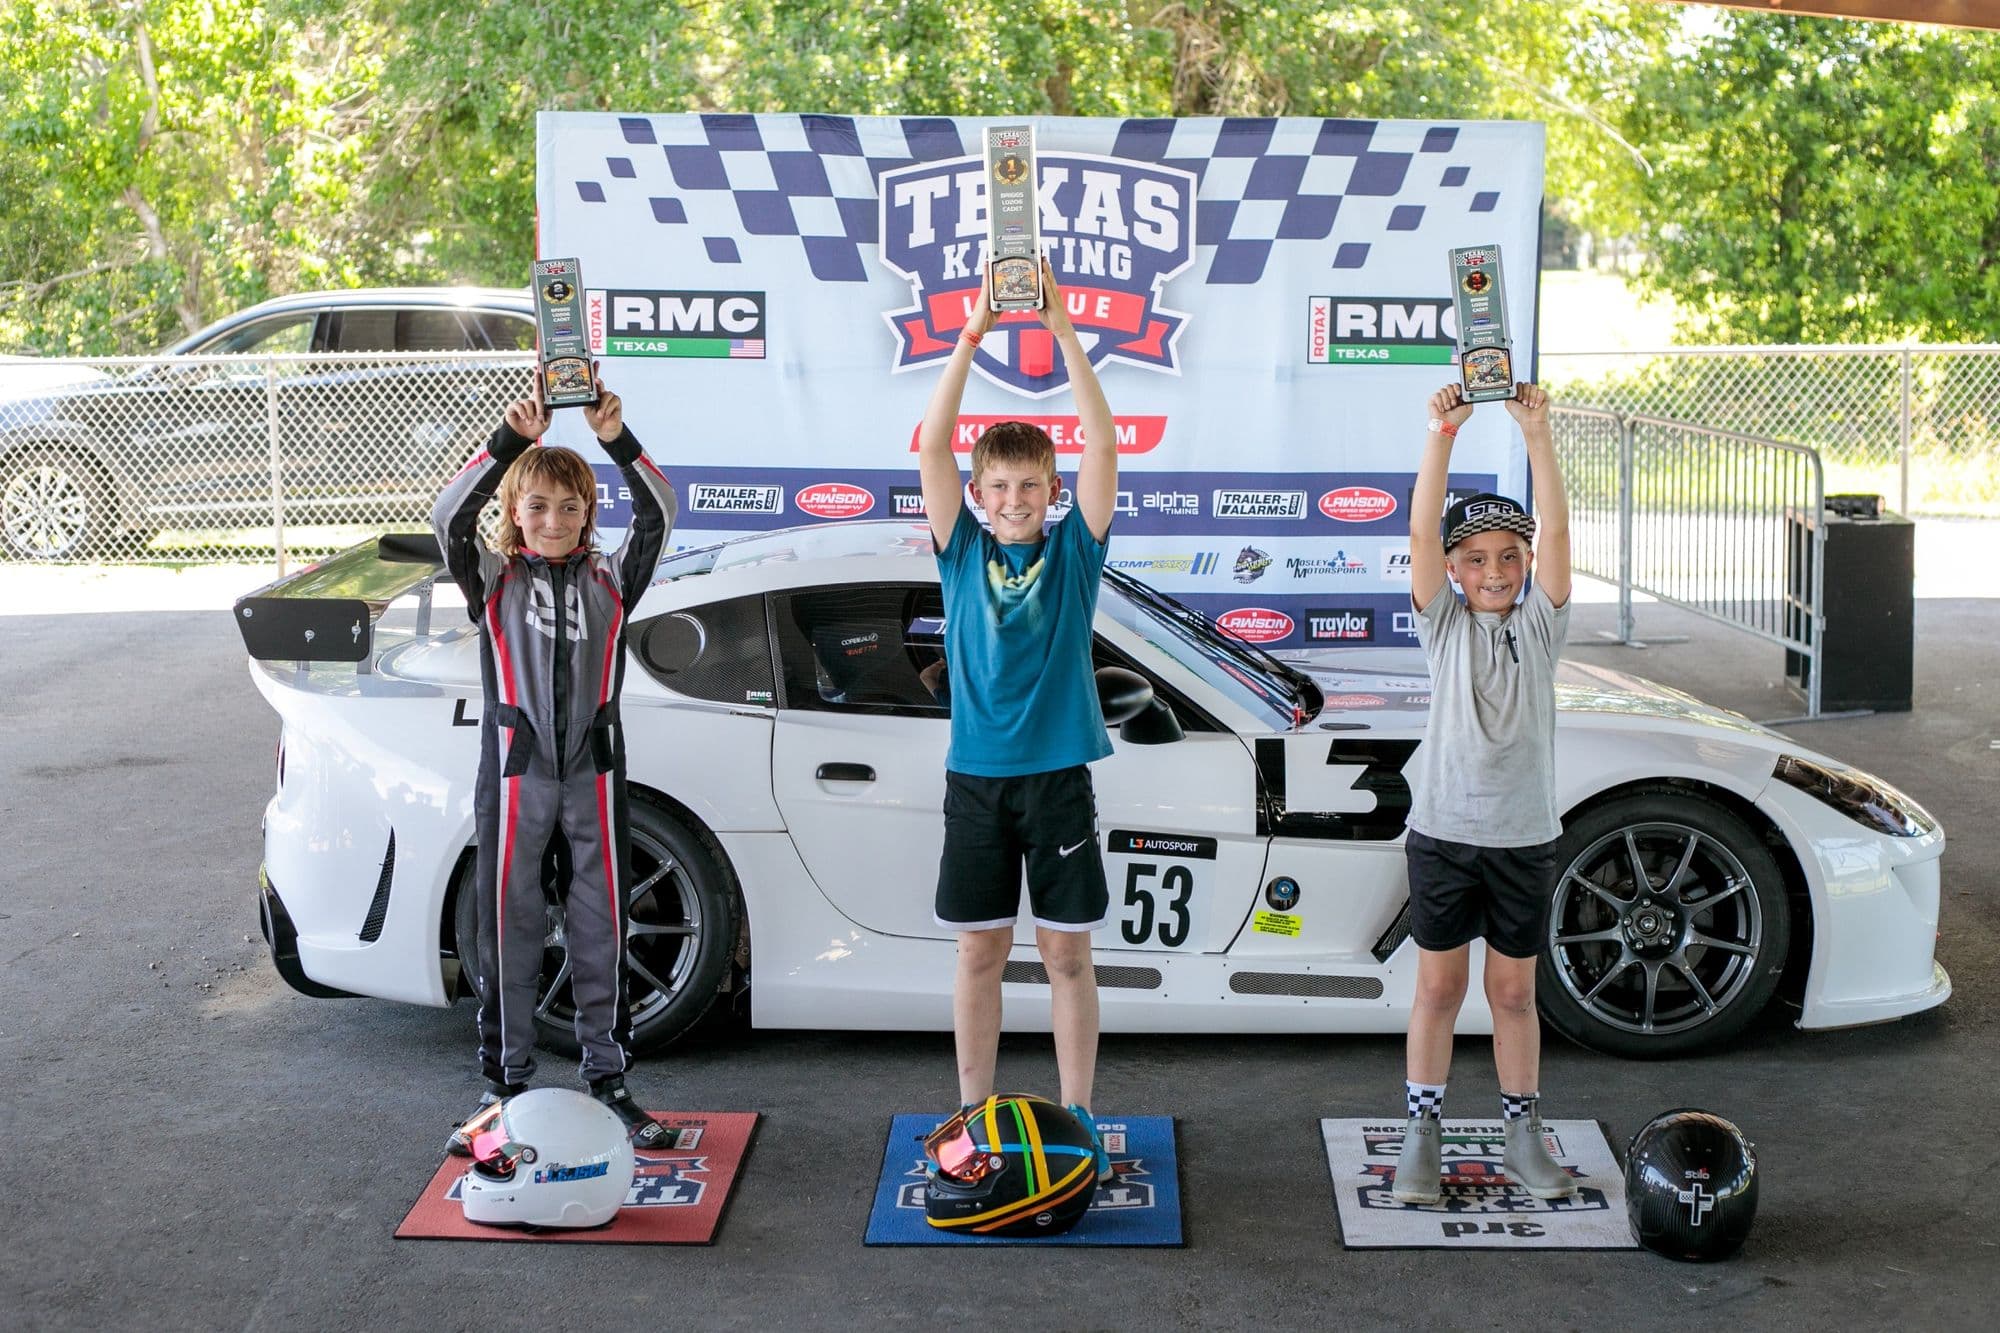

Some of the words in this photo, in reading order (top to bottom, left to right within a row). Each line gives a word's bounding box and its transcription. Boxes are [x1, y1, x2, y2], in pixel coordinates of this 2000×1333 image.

[942, 237, 1132, 280] KTING
[613, 296, 760, 333] RMC
[591, 298, 602, 349] ROTAX
[1314, 306, 1325, 357] ROTAX
[613, 340, 668, 351] TEXAS
[1336, 349, 1390, 359] TEXAS
[801, 492, 868, 504] LAWSON
[1143, 491, 1199, 513] alpha
[1323, 496, 1390, 508] LAWSON
[706, 499, 763, 510] ALARMS
[1229, 505, 1288, 515] ALARMS
[1469, 503, 1513, 517] SPR
[1108, 559, 1194, 571] COMPKART
[1286, 558, 1328, 568] MOSLEY
[1293, 567, 1367, 578] MOTORSPORTS
[1221, 618, 1288, 629] LAWSON
[1309, 612, 1368, 638] Traylor
[1144, 839, 1198, 852] AUTOSPORT
[1121, 862, 1193, 948] 53
[1684, 1168, 1710, 1180] Stilo
[1440, 1221, 1547, 1239] 3rd
